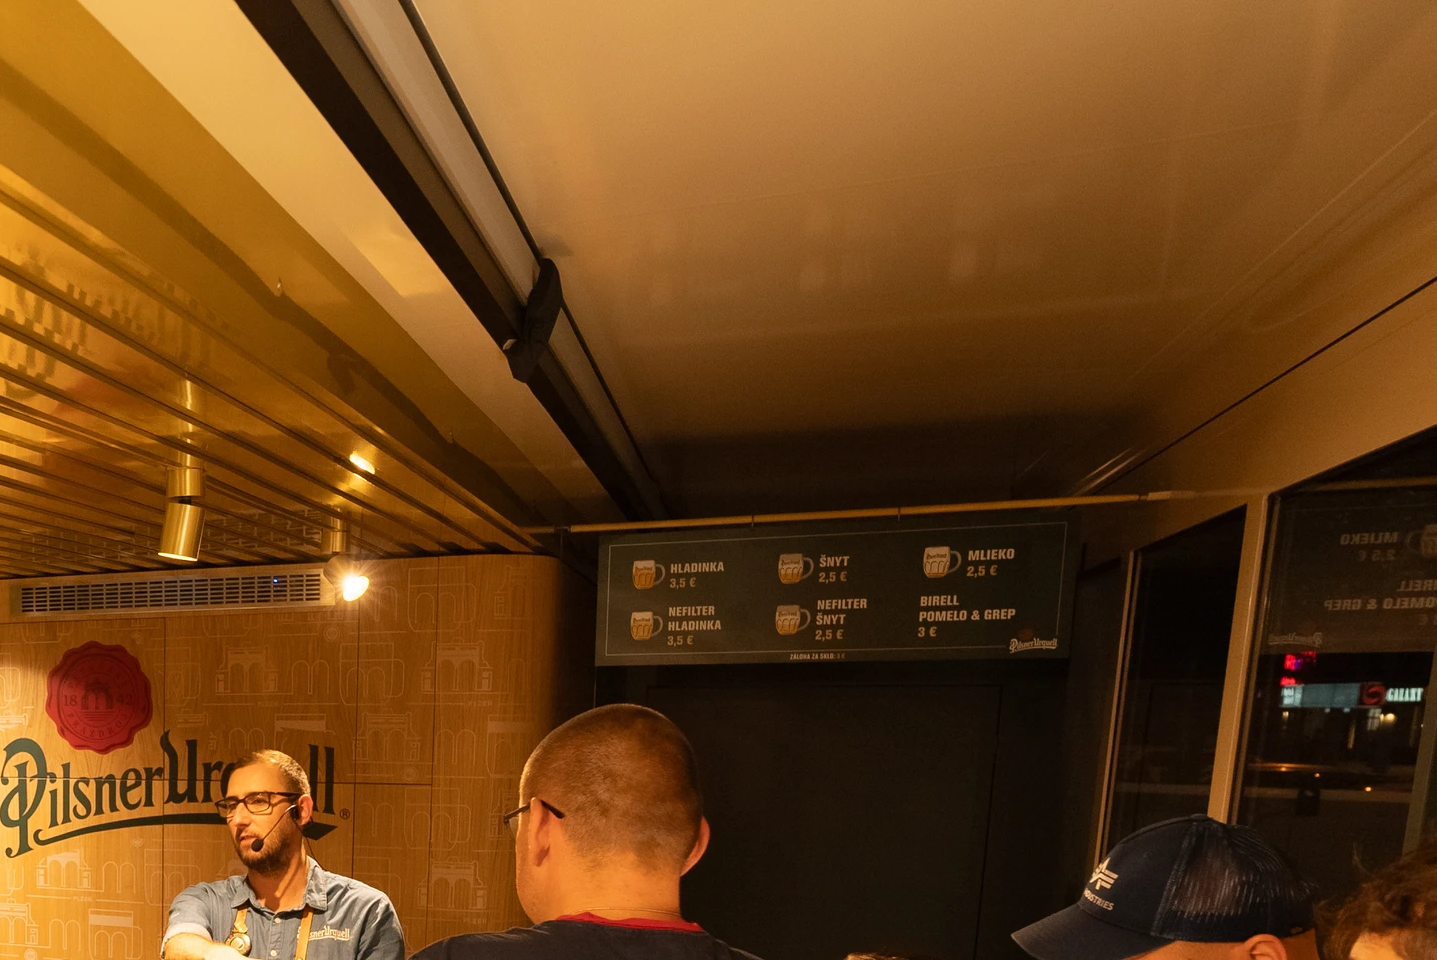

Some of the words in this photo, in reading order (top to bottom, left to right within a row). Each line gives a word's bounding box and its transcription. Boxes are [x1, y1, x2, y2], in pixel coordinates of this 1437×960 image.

[819, 554, 850, 568] ŠNYT
[967, 548, 1016, 561] MLIEKO
[670, 561, 725, 574] HLADINKA
[966, 565, 986, 578] 2,5
[989, 564, 998, 576] €
[669, 578, 686, 590] 3,5
[689, 577, 697, 588] €
[818, 571, 836, 584] 2,5
[839, 571, 848, 582] €
[817, 598, 868, 610] NEFILTER
[920, 594, 960, 607] BIRELL
[668, 605, 715, 617] NEFILTER
[918, 610, 968, 622] POMELO
[970, 609, 980, 621] &
[983, 608, 1016, 620] GREP
[815, 612, 846, 625] ŠNYT
[667, 620, 722, 632] HLADINKA
[917, 626, 926, 638] 3
[928, 626, 938, 637] €
[667, 635, 684, 647] 3,5
[686, 635, 694, 645] €
[815, 629, 833, 641] 2,5
[836, 629, 844, 640] €
